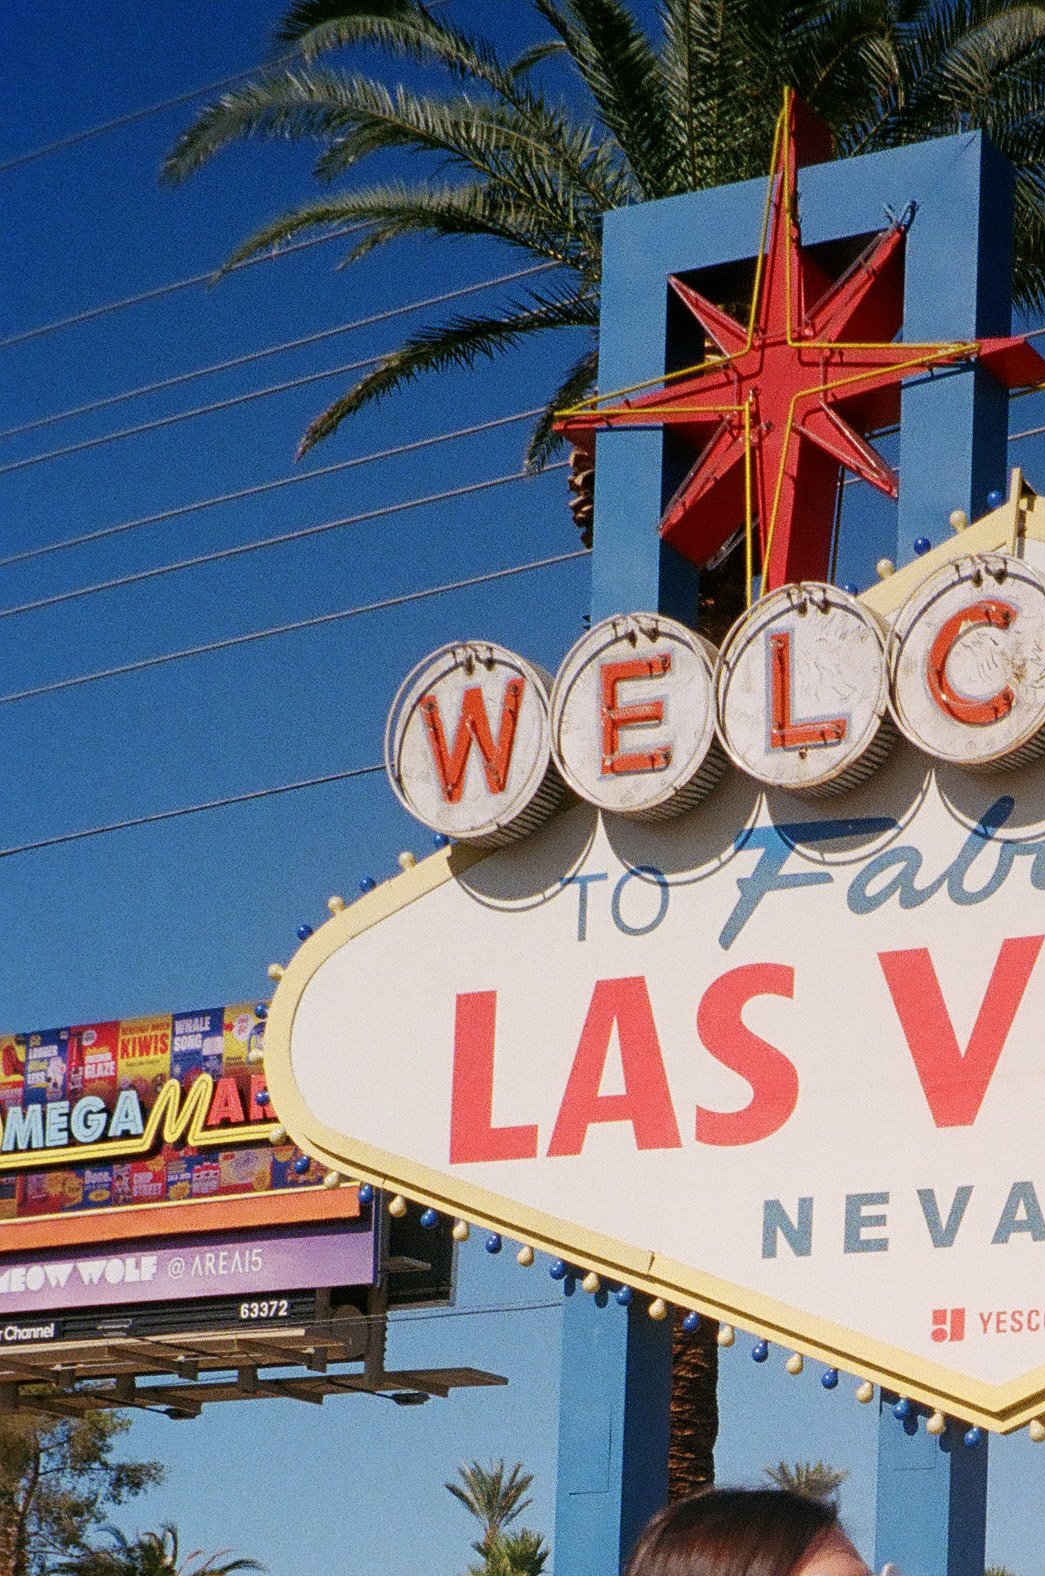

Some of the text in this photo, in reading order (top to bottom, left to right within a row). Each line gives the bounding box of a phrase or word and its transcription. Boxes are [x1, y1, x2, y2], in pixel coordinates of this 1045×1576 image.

[560, 866, 670, 941] TO
[120, 1033, 169, 1059] KIWIS
[449, 963, 799, 1164] LAS
[0, 1090, 144, 1151] MEGA
[76, 1255, 157, 1287] WOLF
[240, 1300, 288, 1319] 63372
[4, 1322, 55, 1341] Channel
